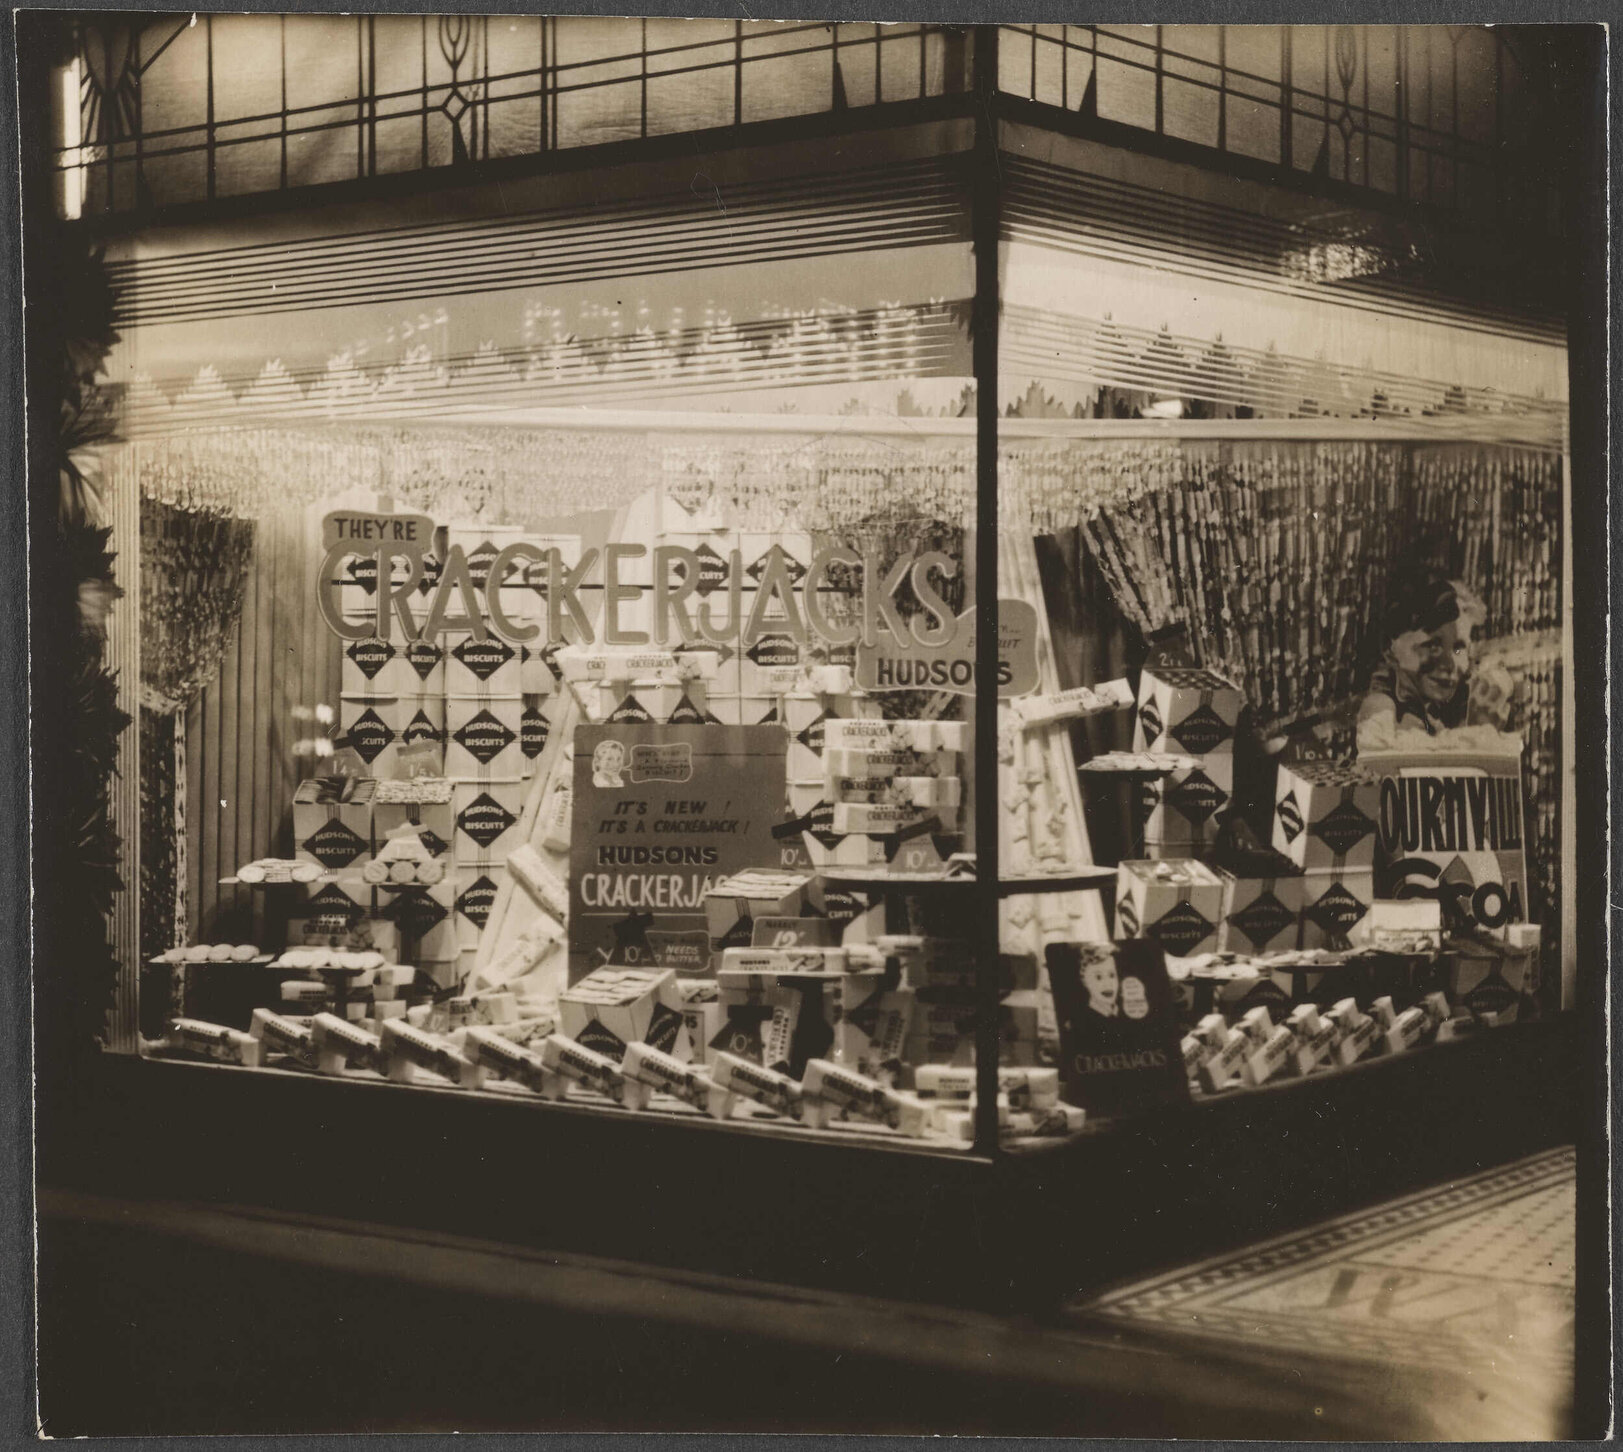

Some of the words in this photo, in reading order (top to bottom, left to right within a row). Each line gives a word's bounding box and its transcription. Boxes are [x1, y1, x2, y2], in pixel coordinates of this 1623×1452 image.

[334, 518, 418, 541] THEY'RE
[317, 541, 958, 648] CRACKERJACKS
[356, 653, 387, 662] BISCUITS
[463, 654, 503, 663] BISCUITS
[758, 655, 797, 663] BISCUITS
[877, 658, 1013, 688] HUDSOS
[354, 720, 385, 732] HUDSONS
[465, 721, 504, 733] HUDSONS
[465, 737, 505, 746] BISCUITS
[465, 805, 504, 817] HUDSONS
[614, 800, 647, 815] IT'S
[664, 800, 708, 815] NEW
[464, 821, 505, 830] BISCUITS
[598, 820, 628, 834] IT'S
[635, 820, 646, 834] A
[315, 831, 356, 842] HUDSONS
[597, 845, 720, 867] HUDSONS
[580, 872, 729, 908] CRACKERJA
